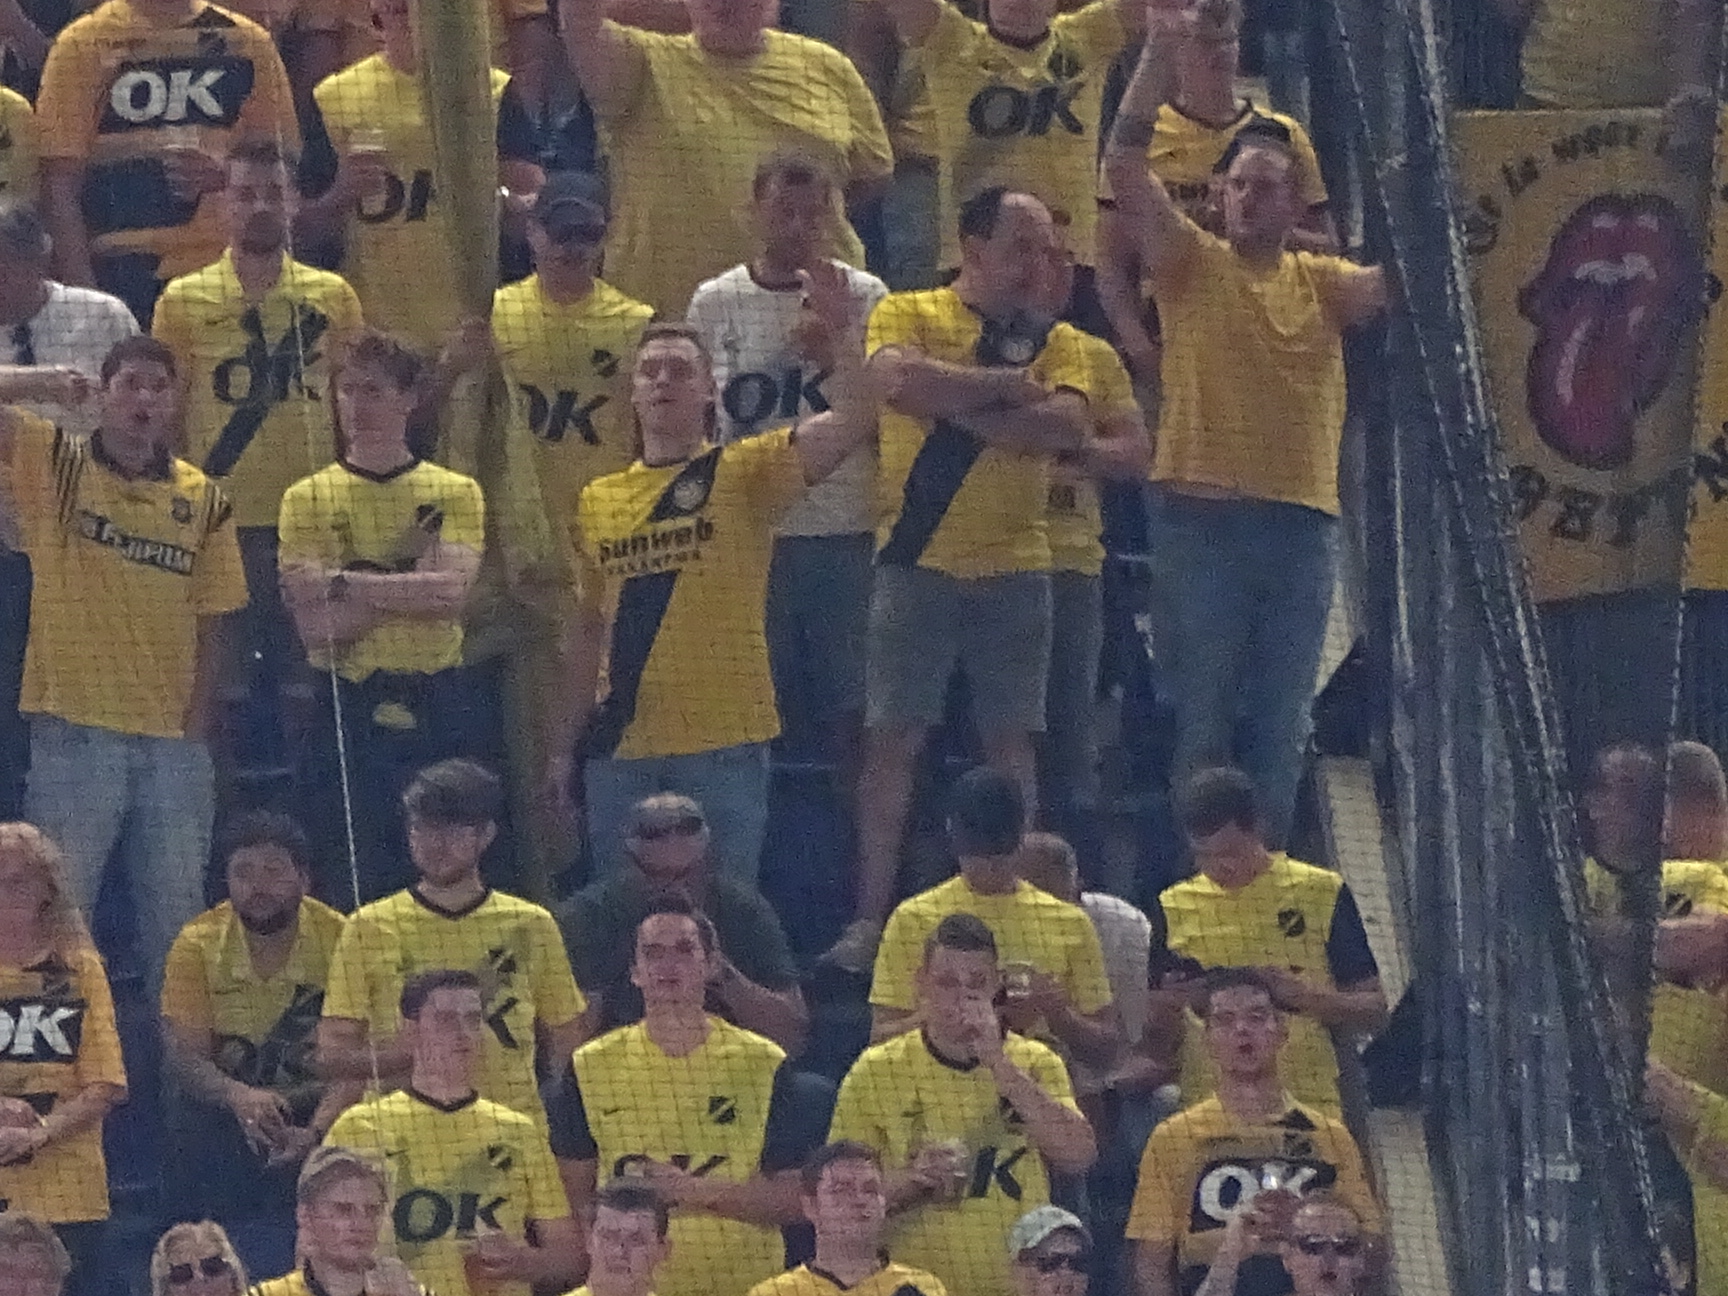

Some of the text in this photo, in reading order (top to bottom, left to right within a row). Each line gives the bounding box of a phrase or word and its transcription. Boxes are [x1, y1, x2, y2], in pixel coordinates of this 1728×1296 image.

[110, 70, 225, 123] OK
[968, 85, 1085, 137] OK
[723, 370, 831, 428] OK
[392, 1188, 509, 1242] OK
